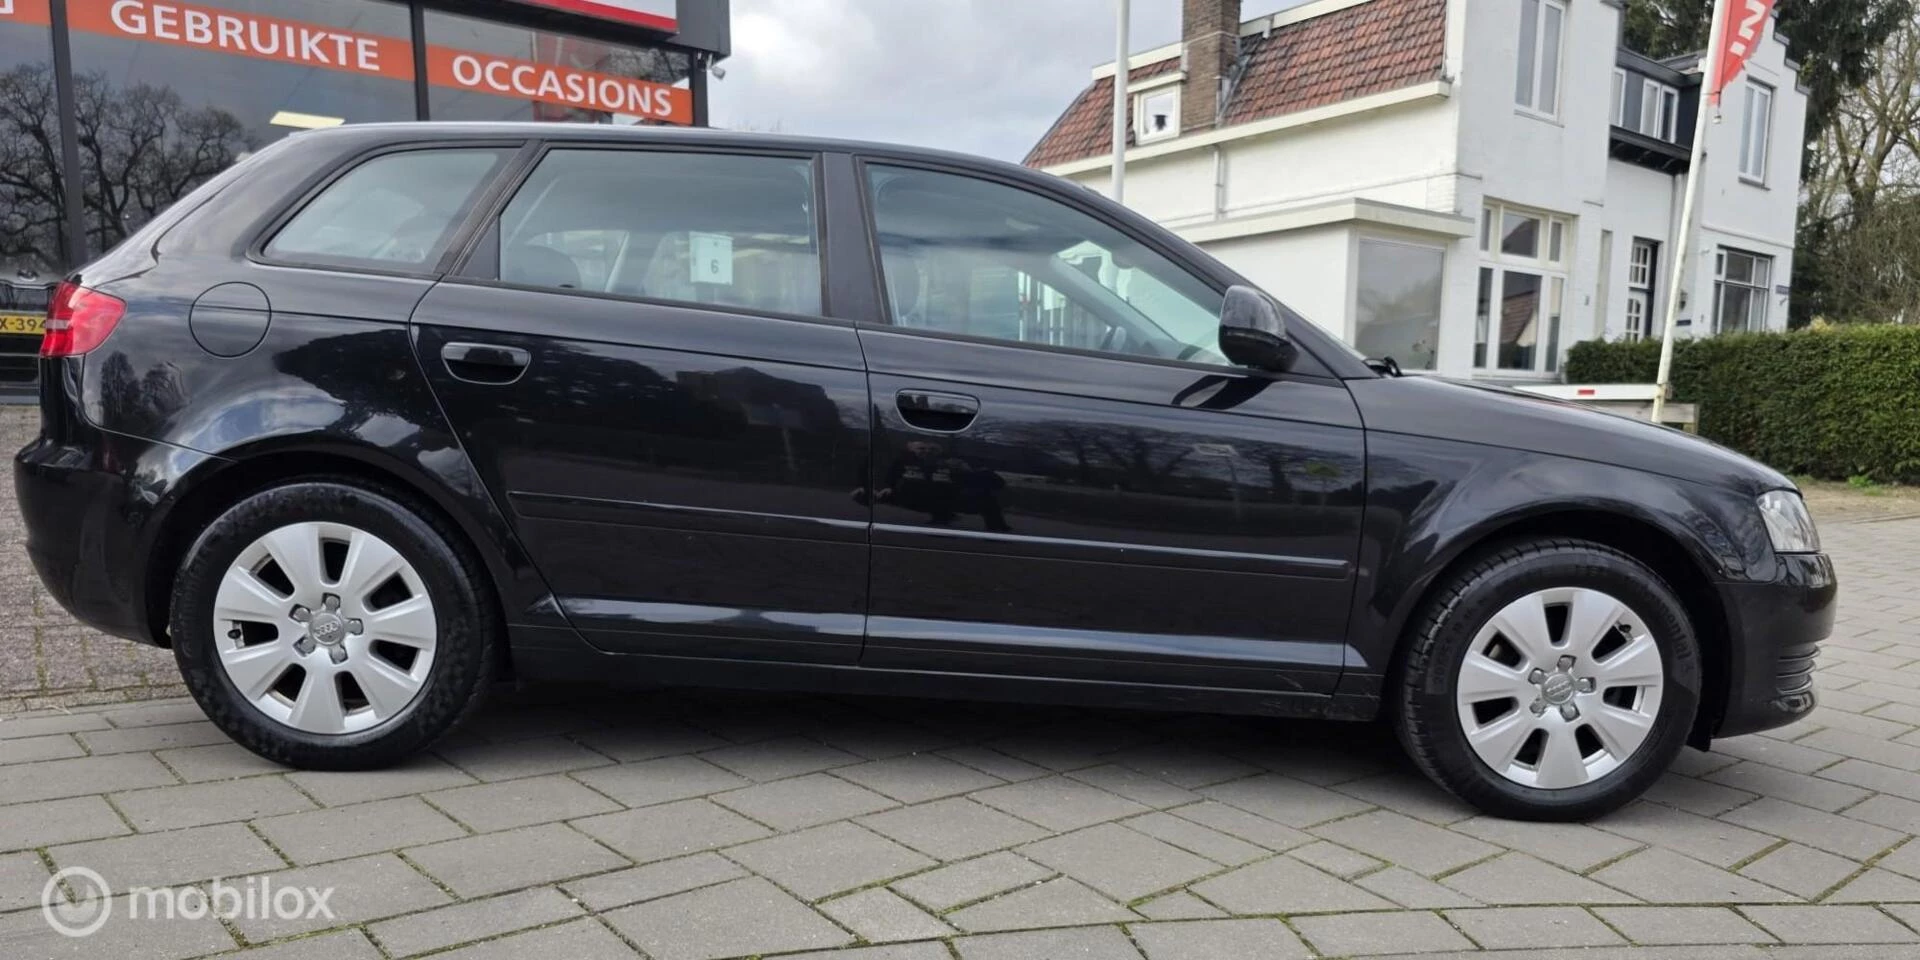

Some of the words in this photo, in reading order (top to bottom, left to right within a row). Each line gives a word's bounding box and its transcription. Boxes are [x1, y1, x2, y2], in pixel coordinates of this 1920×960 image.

[111, 0, 380, 70] GEBRUIKTE
[452, 55, 672, 117] OCCASIONS
[710, 259, 719, 274] 6
